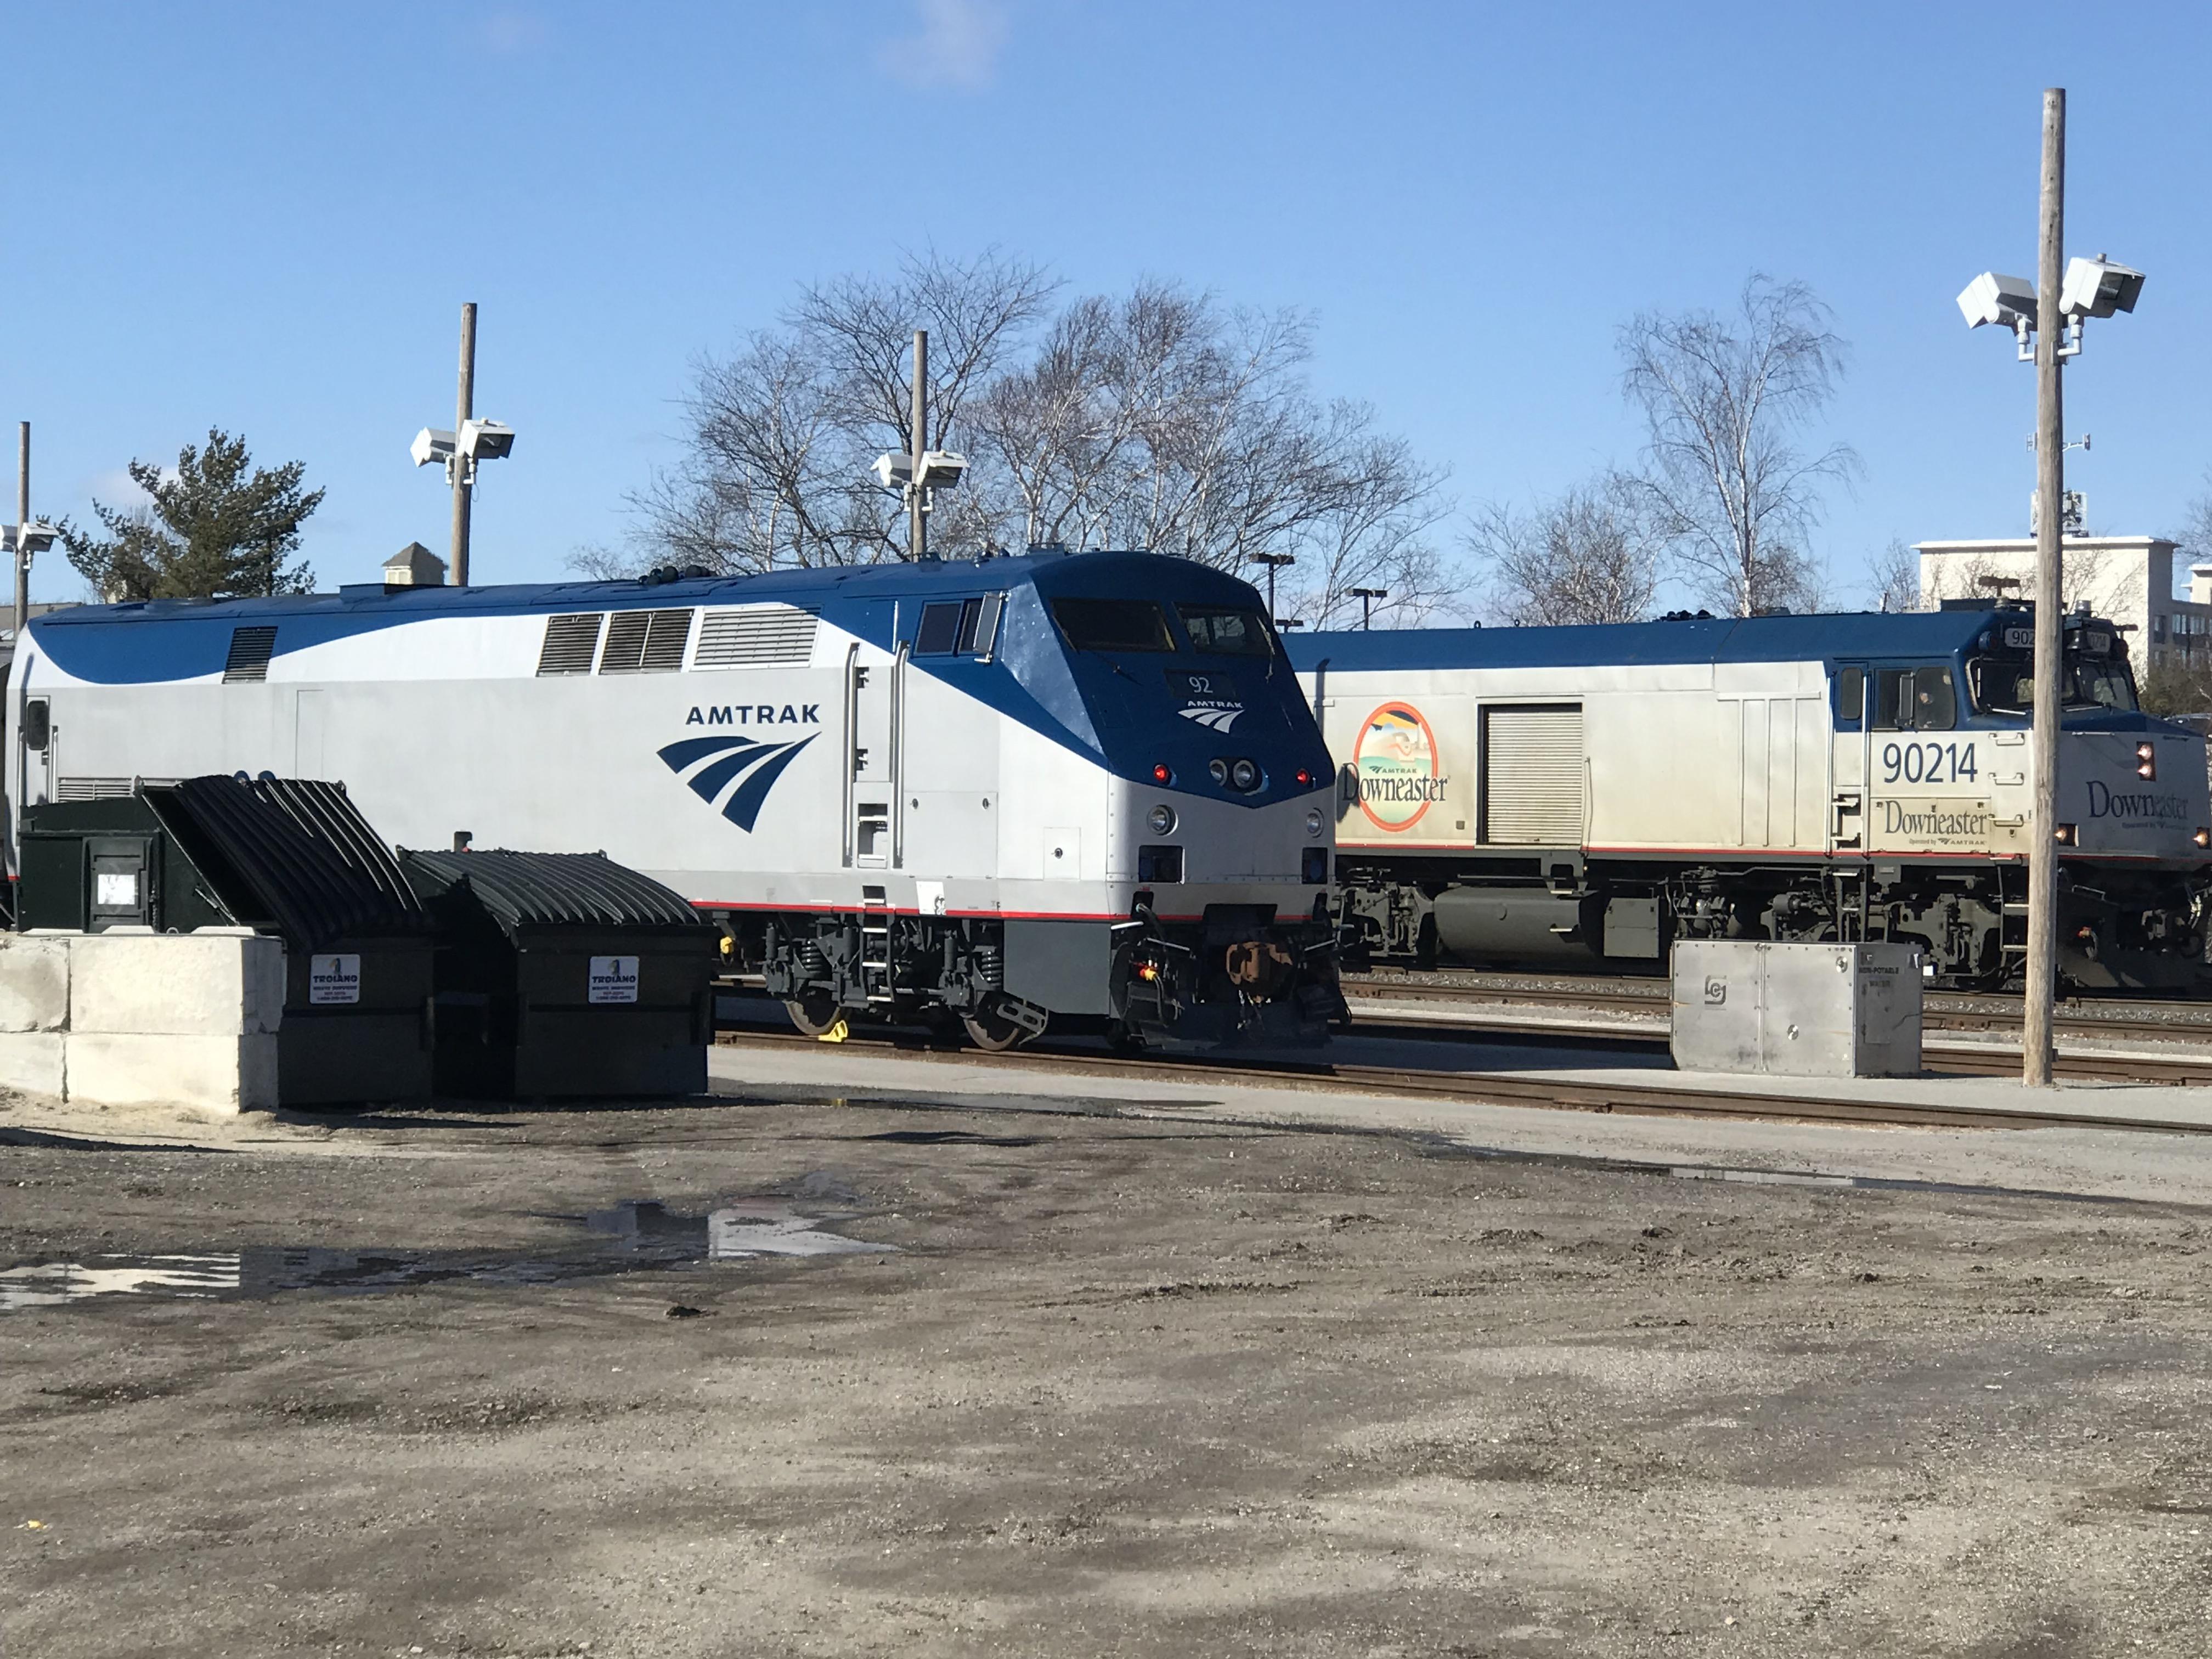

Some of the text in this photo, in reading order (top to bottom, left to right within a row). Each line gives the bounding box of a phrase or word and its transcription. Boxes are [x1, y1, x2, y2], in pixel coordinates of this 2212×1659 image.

[2012, 630, 2036, 645] 902
[1188, 676, 1214, 693] 92
[685, 704, 820, 725] AMTRAK
[1187, 700, 1244, 708] AMTRAK
[1883, 743, 1978, 783] 90214
[1342, 762, 1448, 802] Downeaster
[2086, 781, 2189, 820] Downeaster
[1885, 800, 1987, 834] Downeaster
